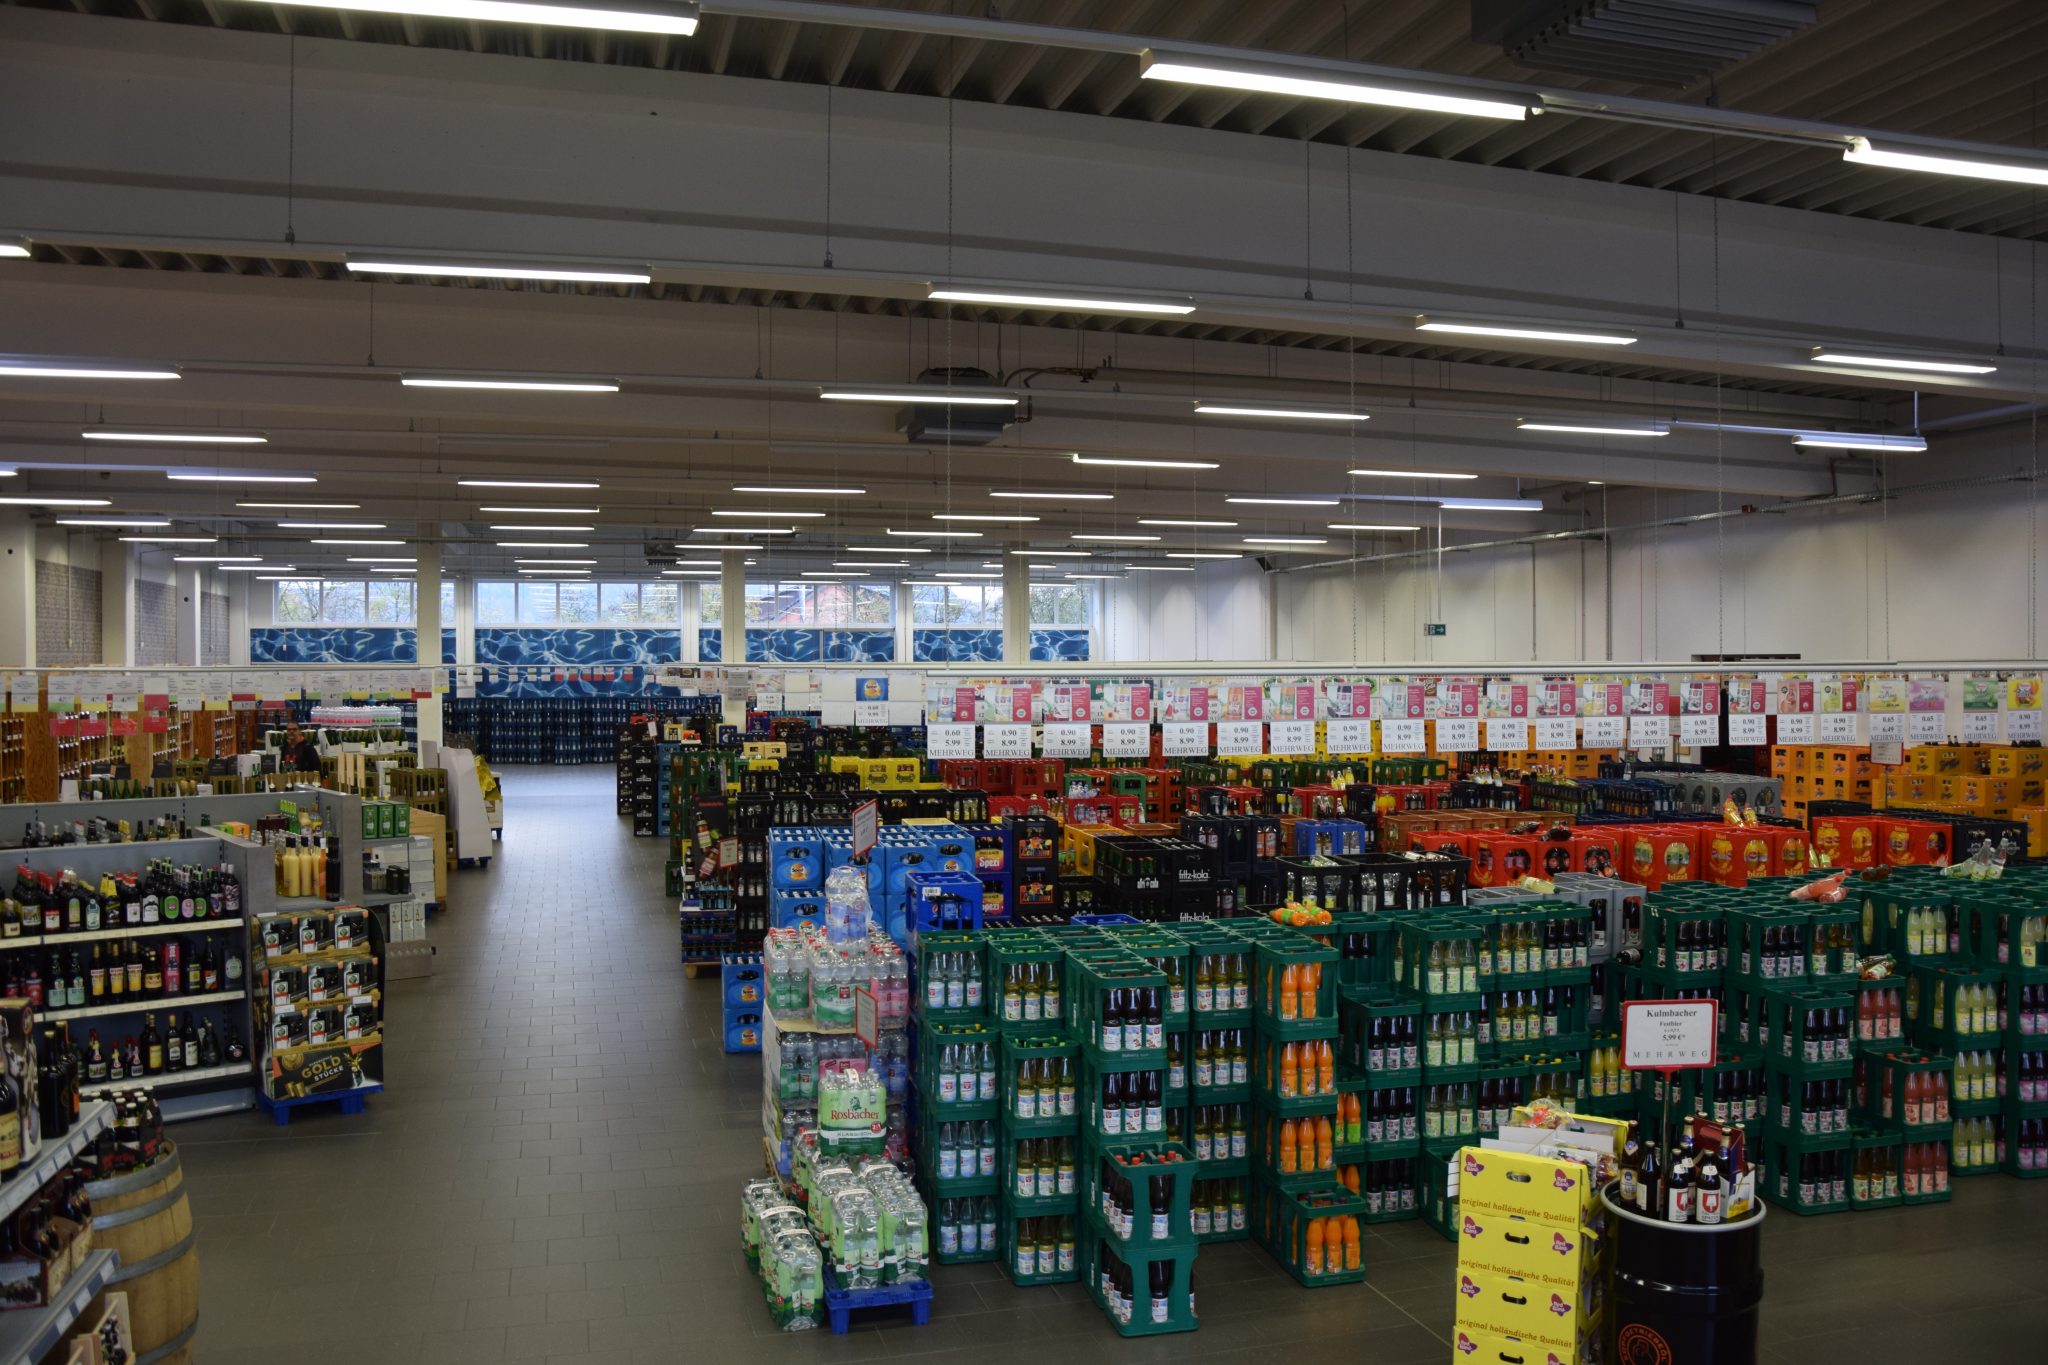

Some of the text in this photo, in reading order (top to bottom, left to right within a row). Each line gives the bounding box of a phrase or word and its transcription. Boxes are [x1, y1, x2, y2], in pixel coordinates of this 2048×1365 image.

[1584, 738, 1622, 746] MEHRWEG
[979, 857, 1000, 868] Spezi
[1179, 869, 1210, 879] fritz-kola
[1646, 1010, 1698, 1018] Kulmbacher
[301, 1056, 342, 1079] GOLD
[314, 1065, 344, 1081] STÜCKE
[831, 1109, 880, 1120] Rosbacher
[1461, 1198, 1576, 1224] original holländische Qualität
[1460, 1259, 1575, 1287] original holländische Qualität
[1458, 1319, 1572, 1348] original holländische Qualität
